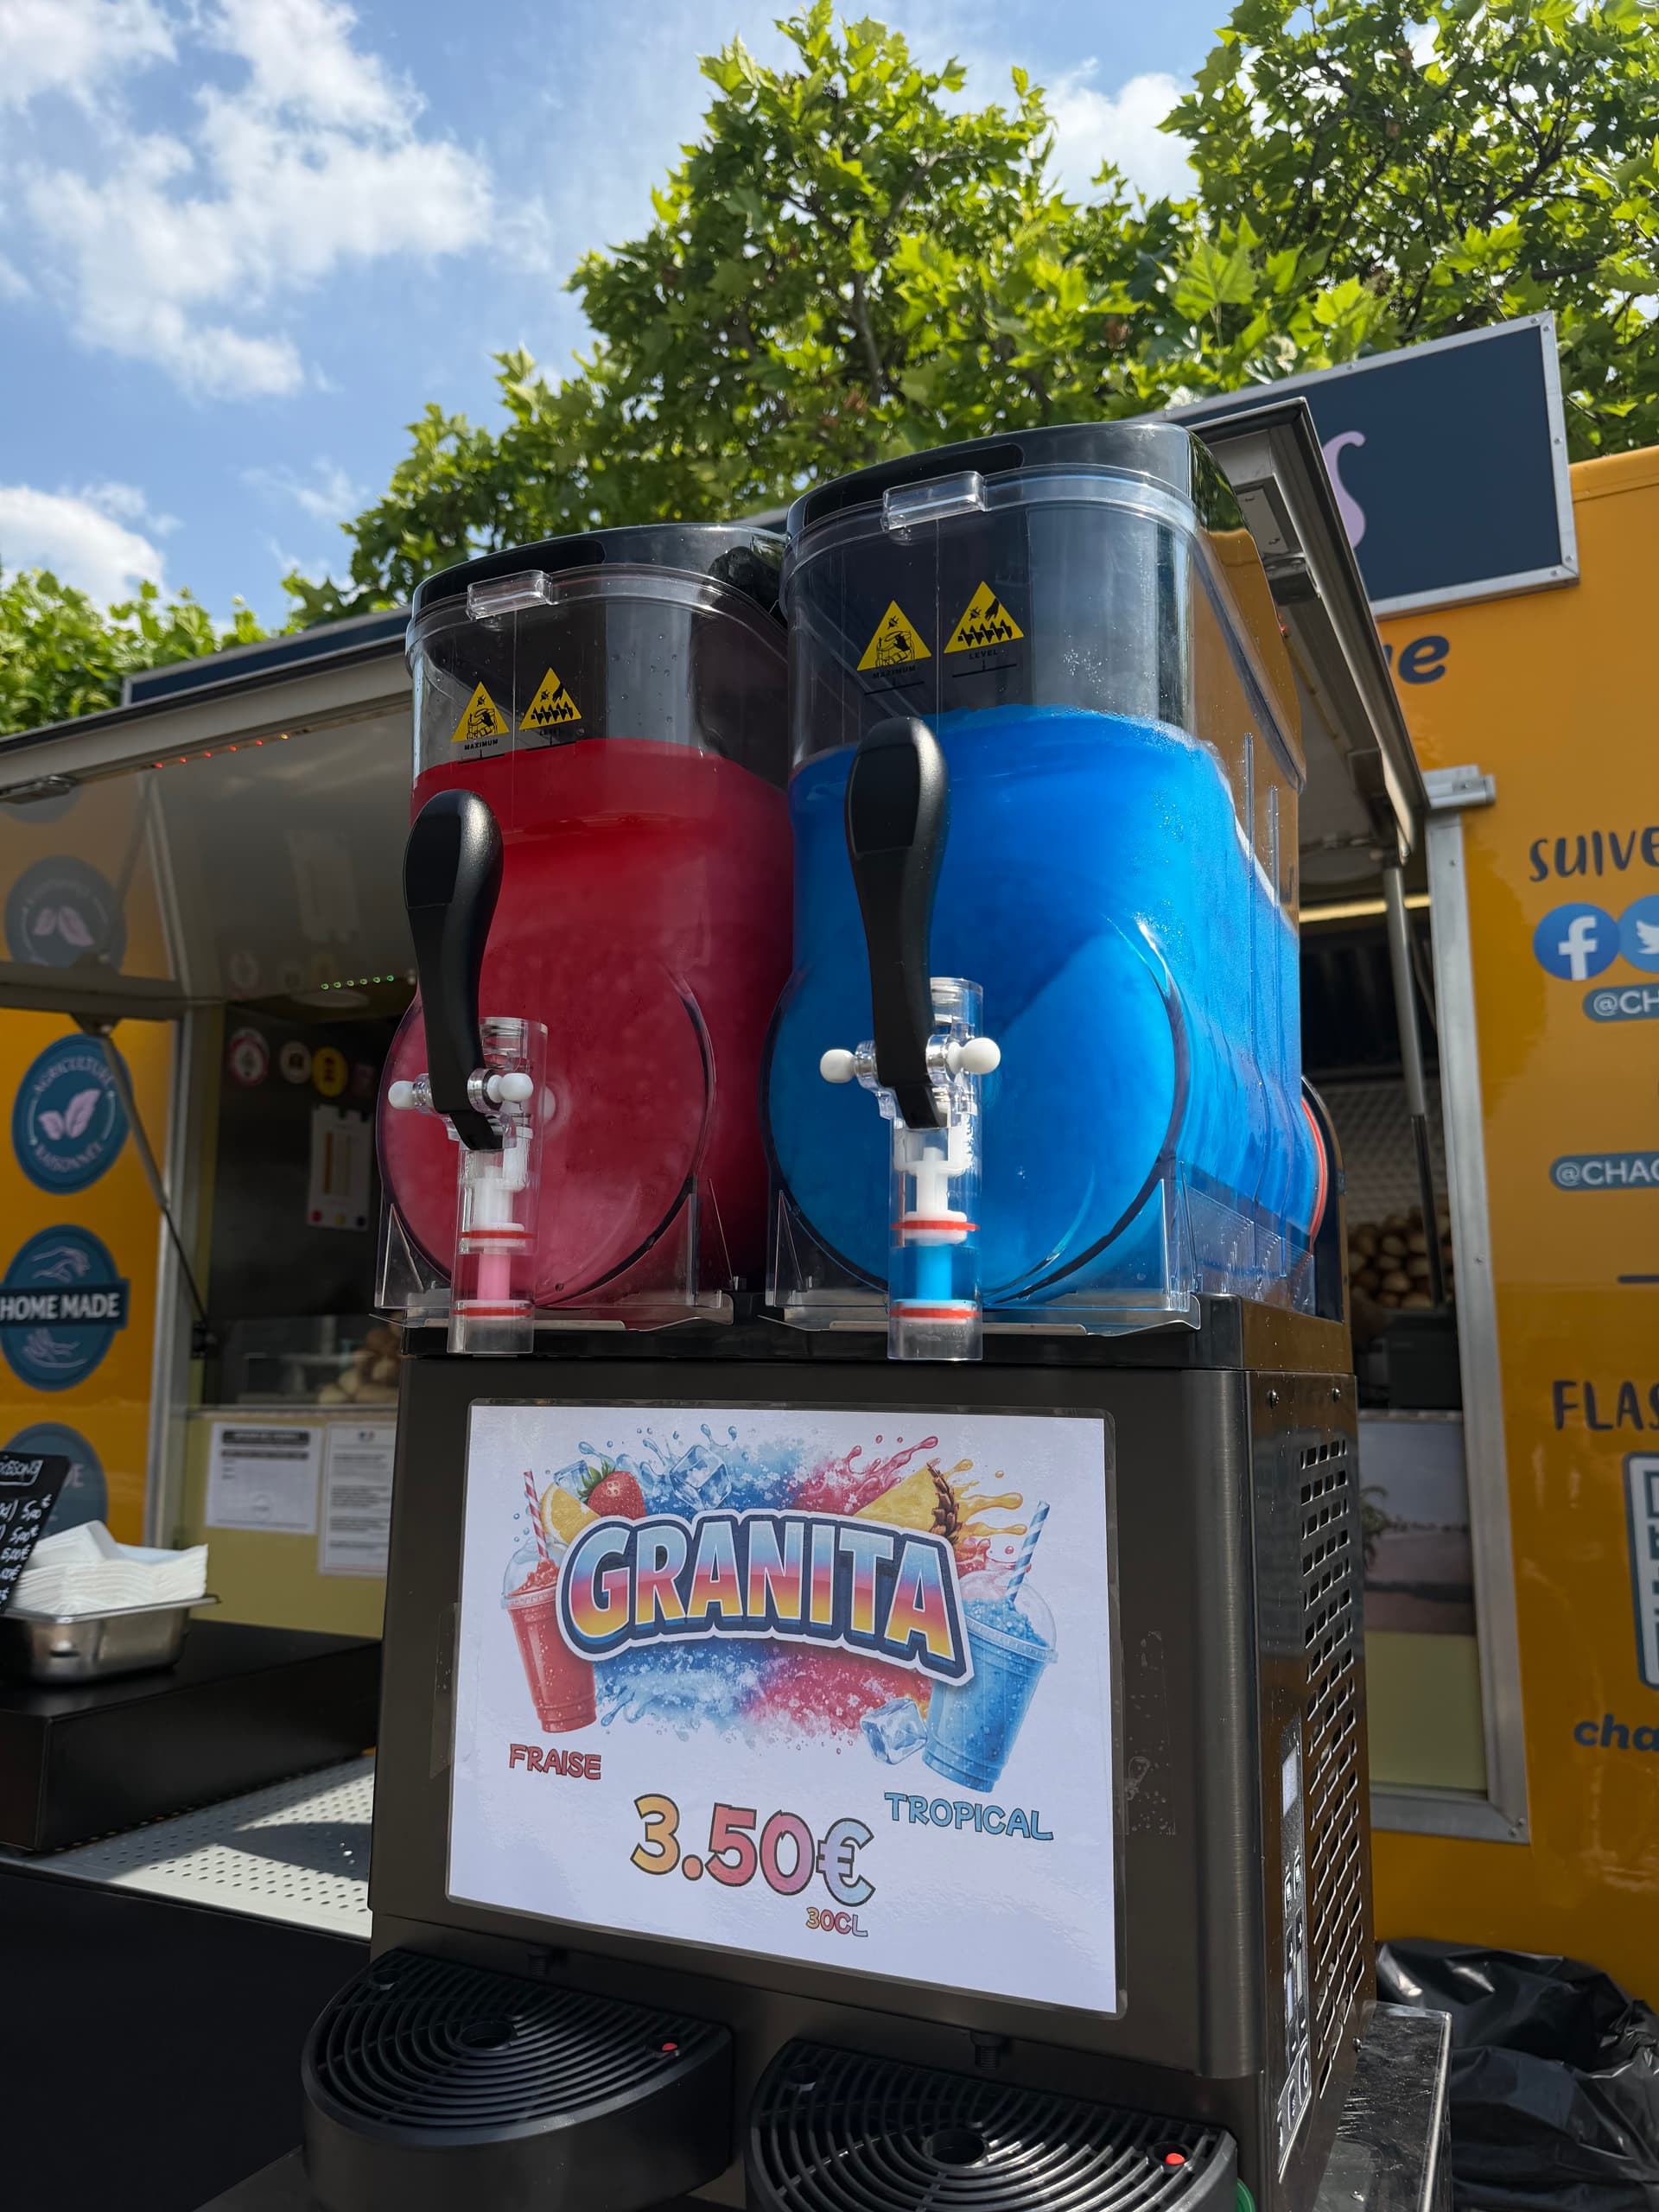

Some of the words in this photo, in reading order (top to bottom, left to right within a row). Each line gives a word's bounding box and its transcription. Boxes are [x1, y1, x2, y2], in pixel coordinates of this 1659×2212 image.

[969, 649, 998, 660] LEVEL
[873, 665, 916, 678] MAXIMUM
[464, 739, 499, 750] MAXIMUM
[0, 1295, 59, 1320] HOME
[60, 1293, 120, 1319] MADE
[562, 1514, 969, 1681] GRANITA
[508, 1743, 601, 1780] FRAISE
[884, 1791, 1053, 1841] TROPICAL
[630, 1794, 875, 1906] 3.50€
[806, 1906, 868, 1937] 30CL
